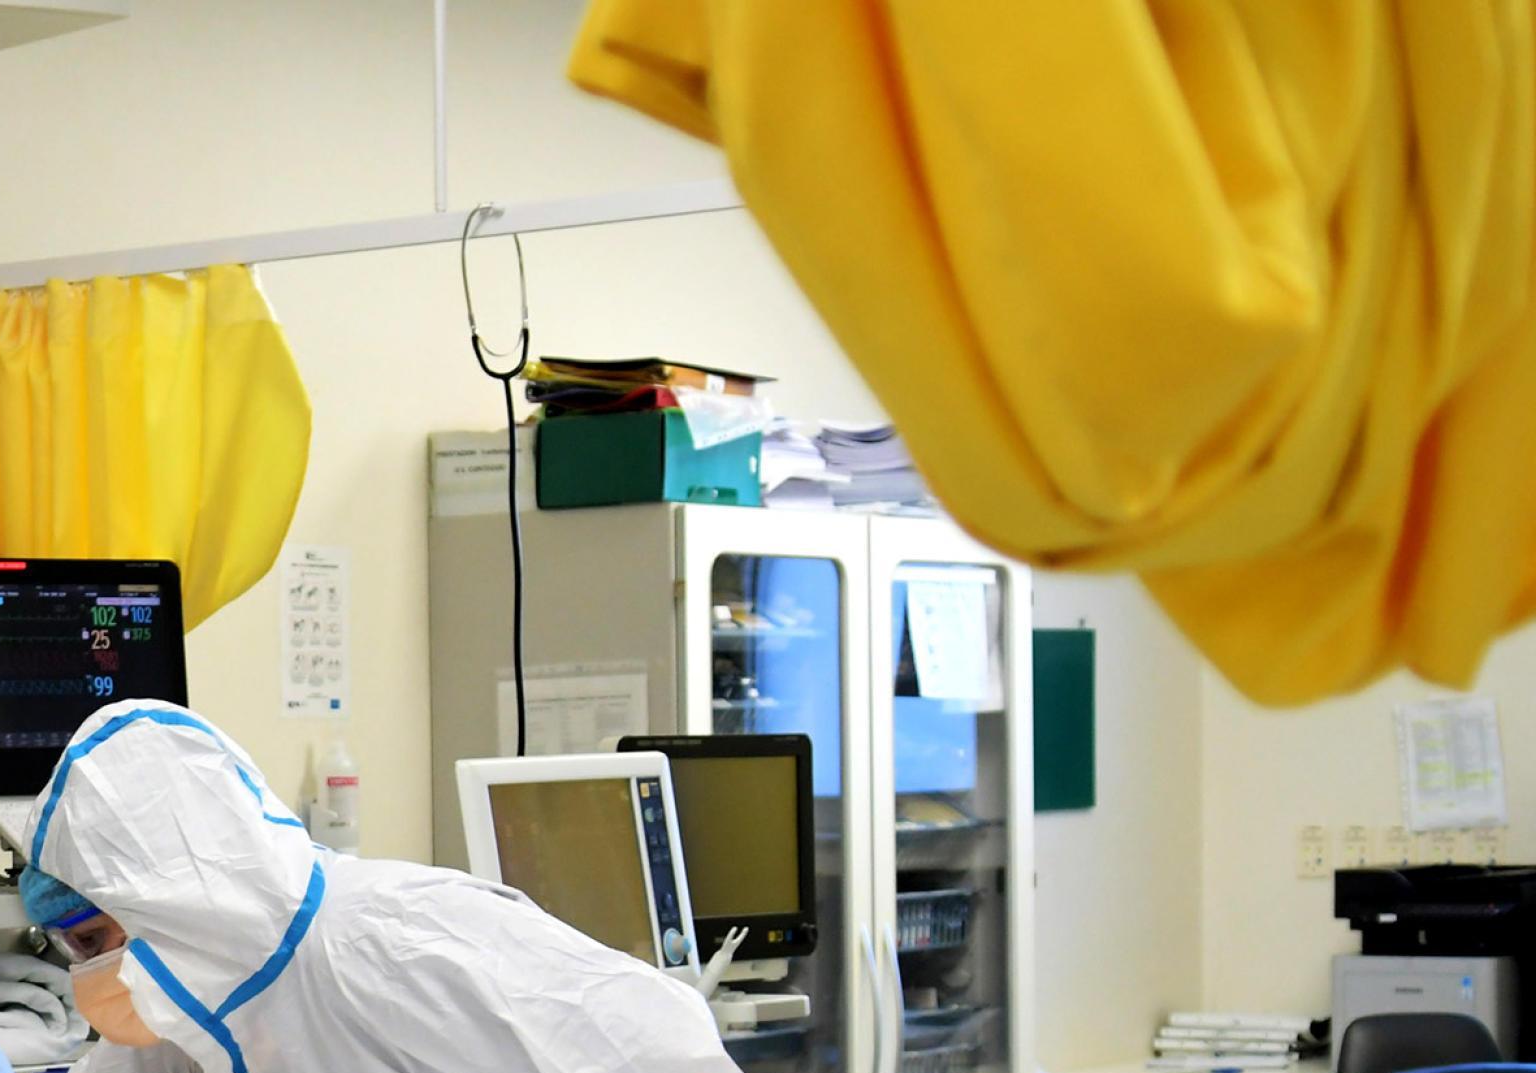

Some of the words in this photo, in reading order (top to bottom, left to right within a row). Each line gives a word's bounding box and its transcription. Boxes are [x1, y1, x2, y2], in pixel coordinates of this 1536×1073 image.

[91, 606, 117, 627] 102
[130, 606, 153, 624] 102
[91, 629, 111, 650] 25
[94, 676, 114, 696] 99
